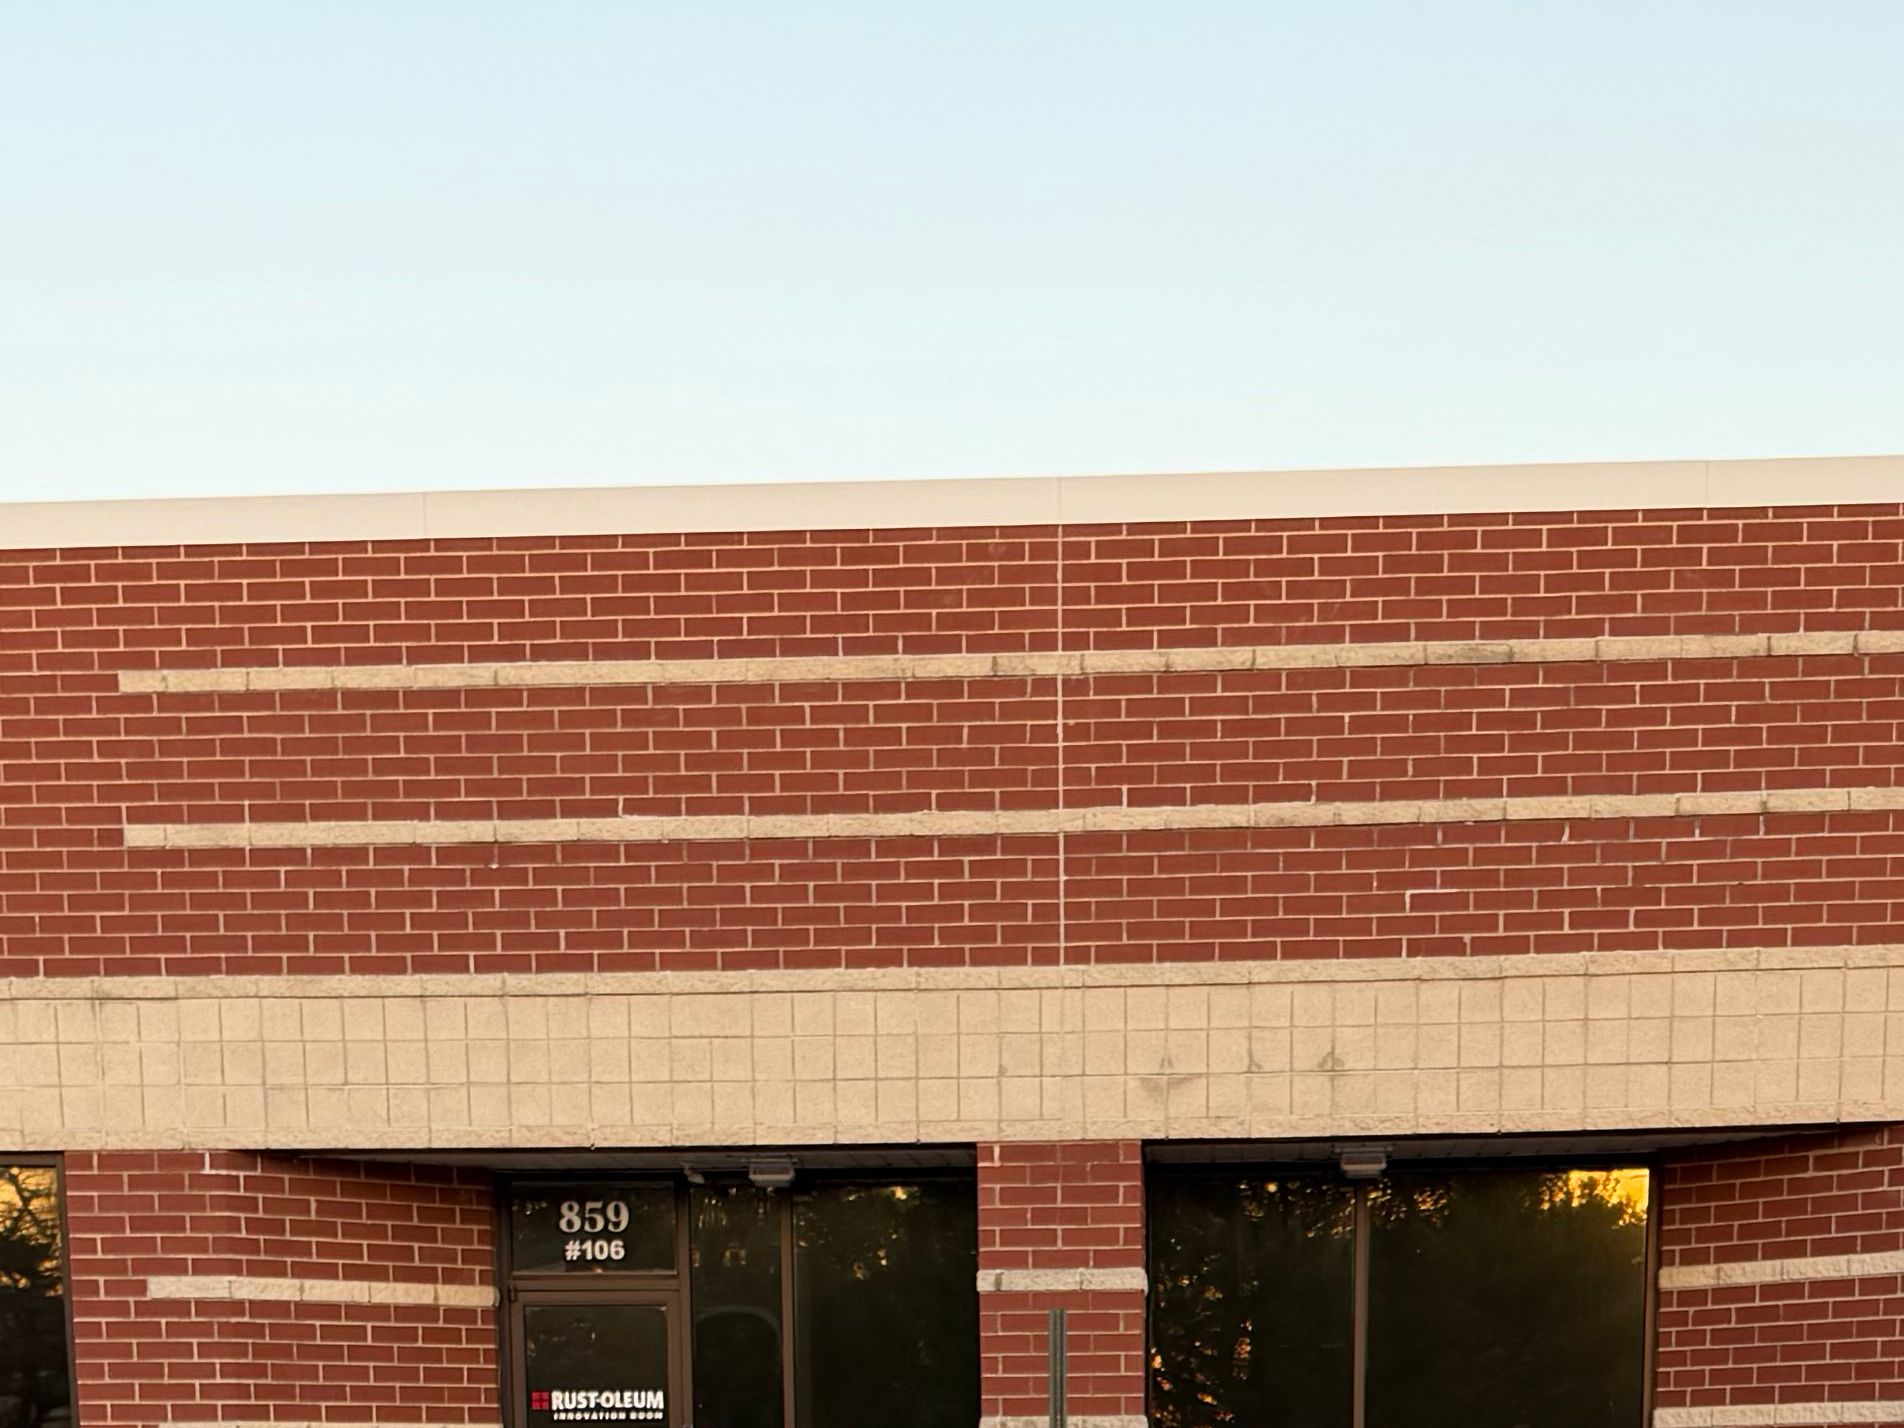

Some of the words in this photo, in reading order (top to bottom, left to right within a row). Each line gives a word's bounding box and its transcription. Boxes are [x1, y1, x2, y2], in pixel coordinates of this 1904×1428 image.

[559, 1200, 630, 1233] 859
[564, 1240, 626, 1261] #106
[551, 1390, 665, 1411] RUST-OLEUM
